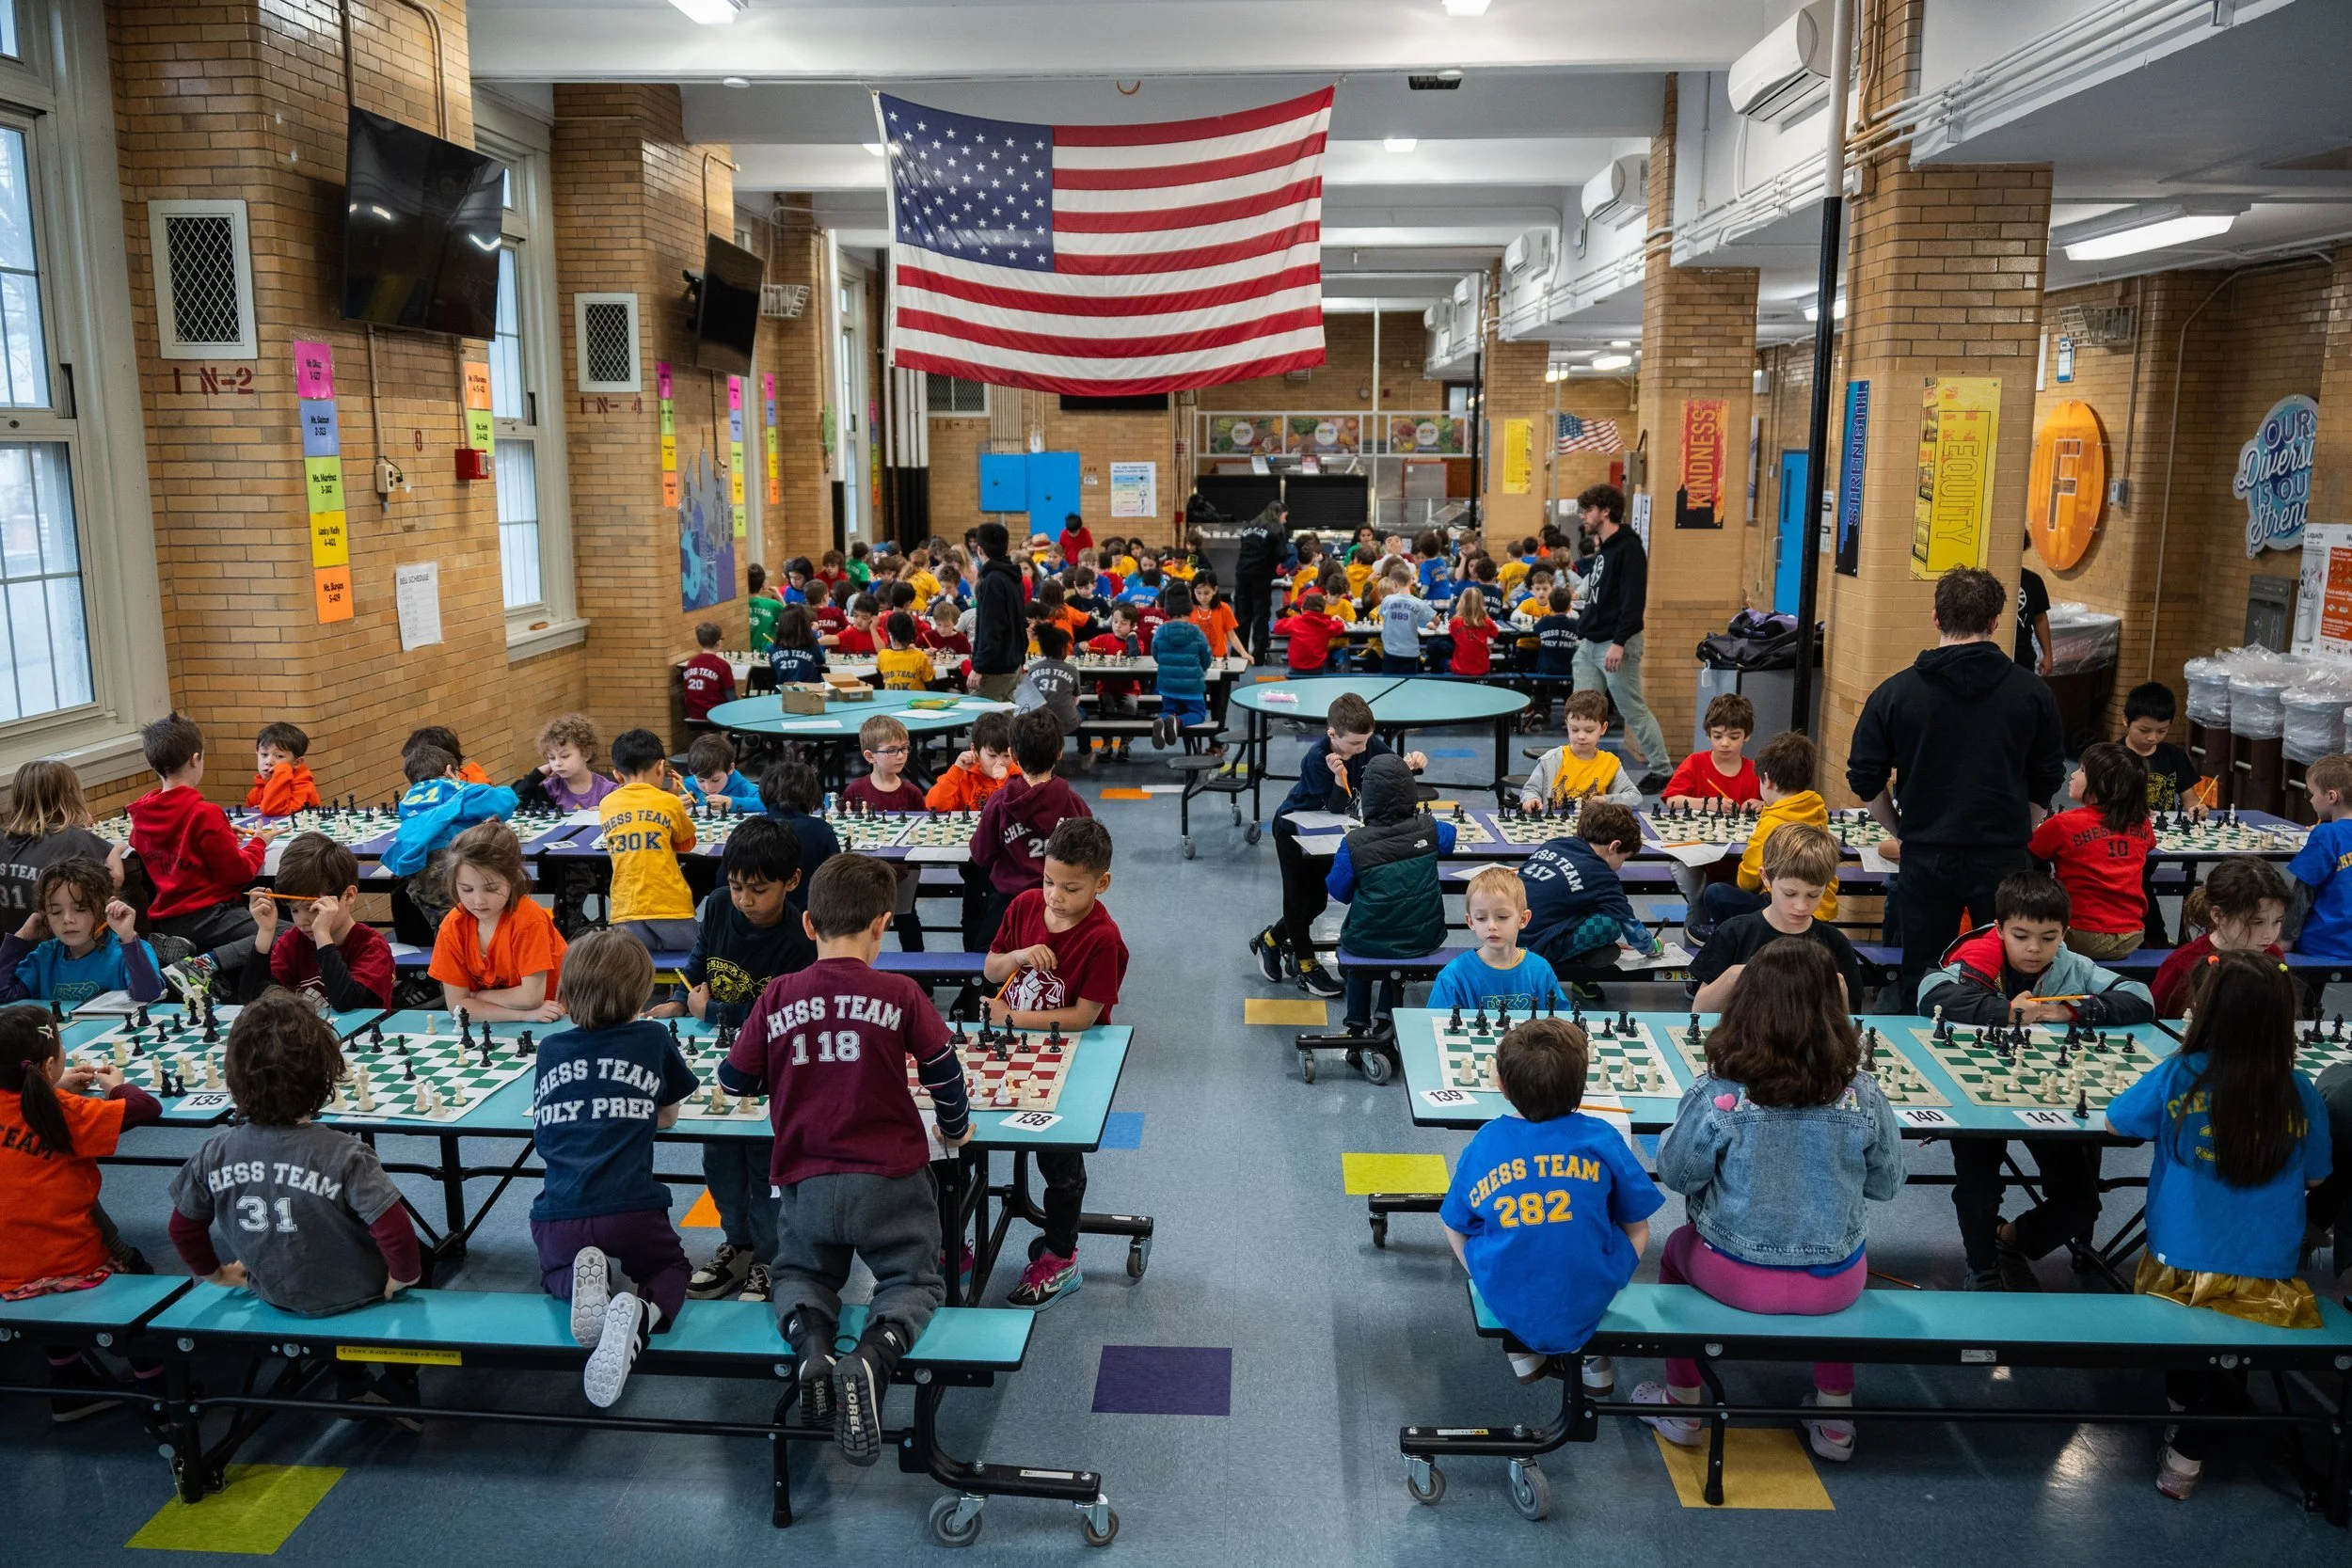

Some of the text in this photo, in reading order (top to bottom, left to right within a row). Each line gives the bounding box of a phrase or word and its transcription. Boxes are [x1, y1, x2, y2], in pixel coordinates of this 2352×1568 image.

[199, 367, 253, 395] N-2
[2264, 409, 2312, 450] OUR
[1687, 408, 1716, 510] KINDNESS
[1849, 390, 1867, 526] STRENGTH
[1935, 439, 1980, 546] EQUITY
[2046, 439, 2084, 531] F
[1242, 527, 1267, 538] COACH
[408, 574, 429, 583] SCHEDULE
[780, 659, 798, 669] 217
[791, 649, 813, 662] TEAM
[688, 678, 705, 690] 20
[699, 668, 719, 680] TEAM
[1039, 678, 1057, 691] 31
[1053, 669, 1073, 683] TEAM
[637, 810, 672, 829] TEAM
[1004, 822, 1033, 844] CHE
[2106, 840, 2129, 858] 10
[9, 863, 42, 881] TEA
[1522, 862, 1556, 882] 217
[1554, 856, 1584, 894] TEAM
[767, 995, 903, 1042] HESS TEAM
[792, 1030, 860, 1065] 118
[596, 1057, 661, 1098] TEAM
[188, 1094, 229, 1106] 135
[1429, 1091, 1464, 1101] 139
[592, 1097, 656, 1120] PREP
[1016, 1112, 1053, 1126] 138
[1905, 1110, 1945, 1122] 140
[2026, 1112, 2067, 1123] 141
[0, 1124, 54, 1160] EAM
[273, 1162, 342, 1200] TEAM
[1469, 1154, 1599, 1208] CHESS TEAM
[235, 1196, 298, 1233] 31
[1493, 1189, 1573, 1228] 282
[815, 1380, 827, 1416] SOREL
[846, 1381, 861, 1435] SOREL
